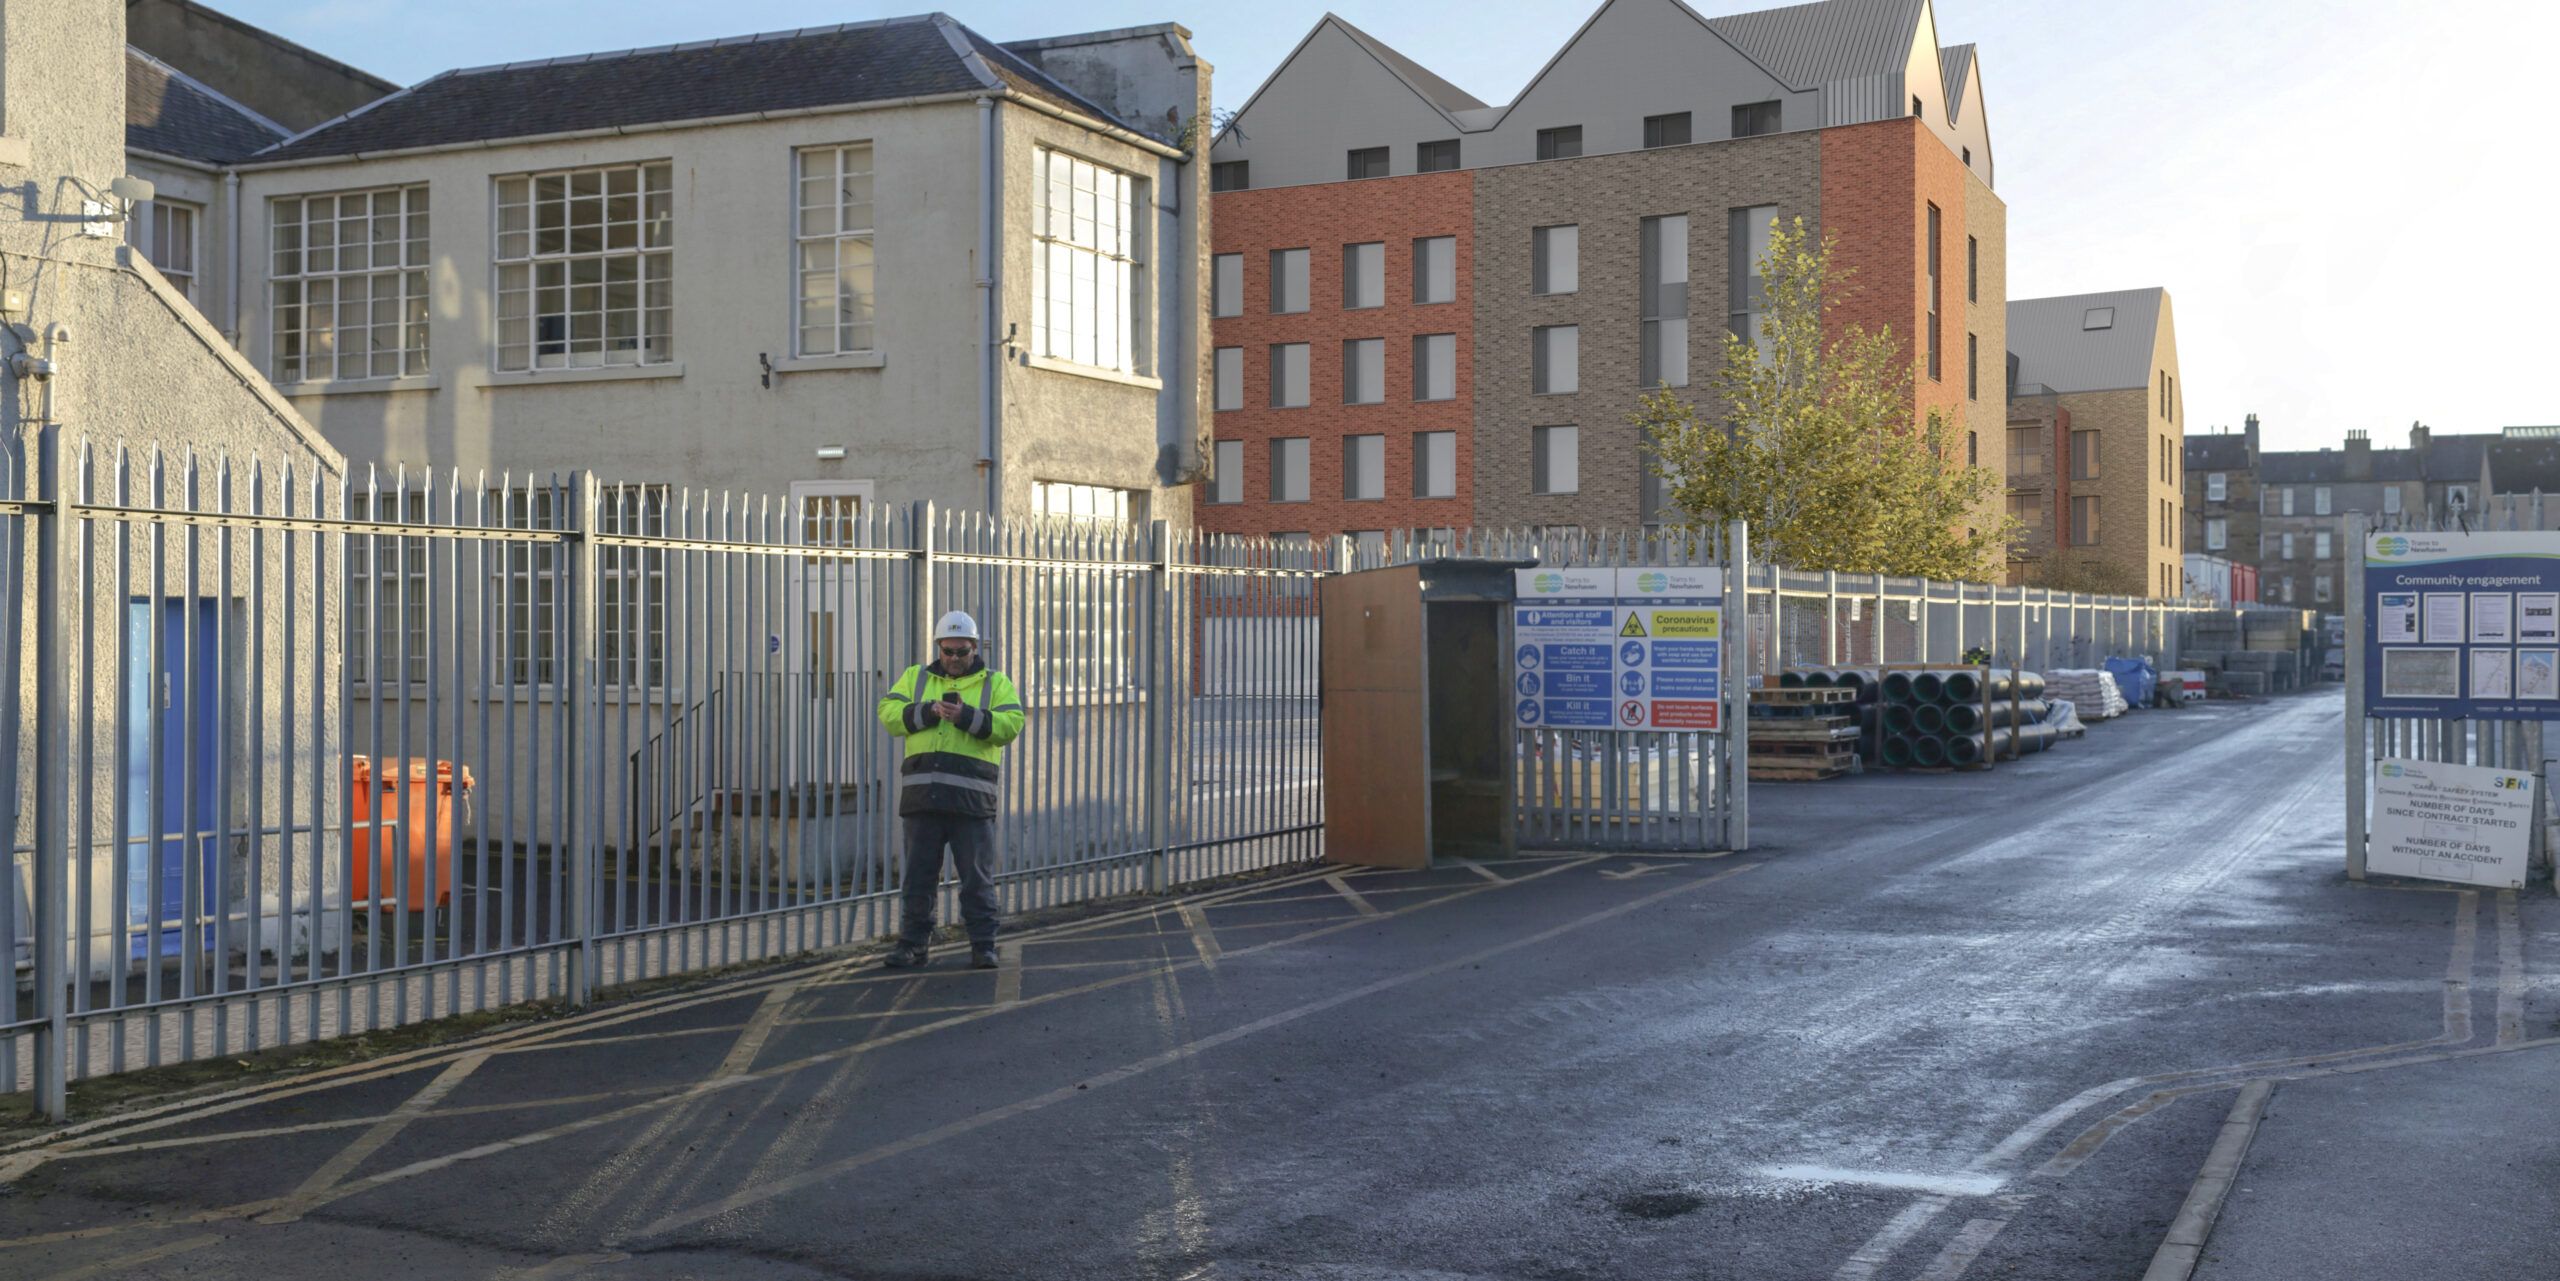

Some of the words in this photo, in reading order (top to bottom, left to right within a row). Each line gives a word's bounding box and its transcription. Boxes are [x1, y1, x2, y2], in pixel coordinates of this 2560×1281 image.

[2396, 574, 2464, 588] Community
[2466, 575, 2541, 587] engagement
[1541, 611, 1574, 619] Attention
[1575, 611, 1584, 619] all
[1585, 611, 1602, 619] staff
[1656, 615, 1715, 625] Coronavirus
[1662, 625, 1709, 634] precautions
[1560, 646, 1587, 655] Catch
[1589, 646, 1596, 655] it
[1566, 674, 1582, 683] Bin
[1583, 674, 1590, 683] it
[1566, 701, 1582, 710] Kill
[1583, 701, 1590, 710] it
[2494, 776, 2528, 790] SFN
[2469, 789, 2499, 797] SYSTEM
[2410, 800, 2451, 811] NUMBER
[2453, 804, 2466, 812] OF
[2469, 806, 2495, 815] DAYS
[2387, 807, 2415, 817] SINCE
[2417, 811, 2470, 823] CONTRACT
[2472, 816, 2517, 829] STARTED
[2406, 836, 2447, 848] NUMBER
[2449, 841, 2463, 849] OF
[2465, 843, 2491, 853] DAYS
[2392, 845, 2435, 857] WITHOUT
[2437, 850, 2451, 858] AN
[2452, 852, 2503, 865] ACCIDENT
